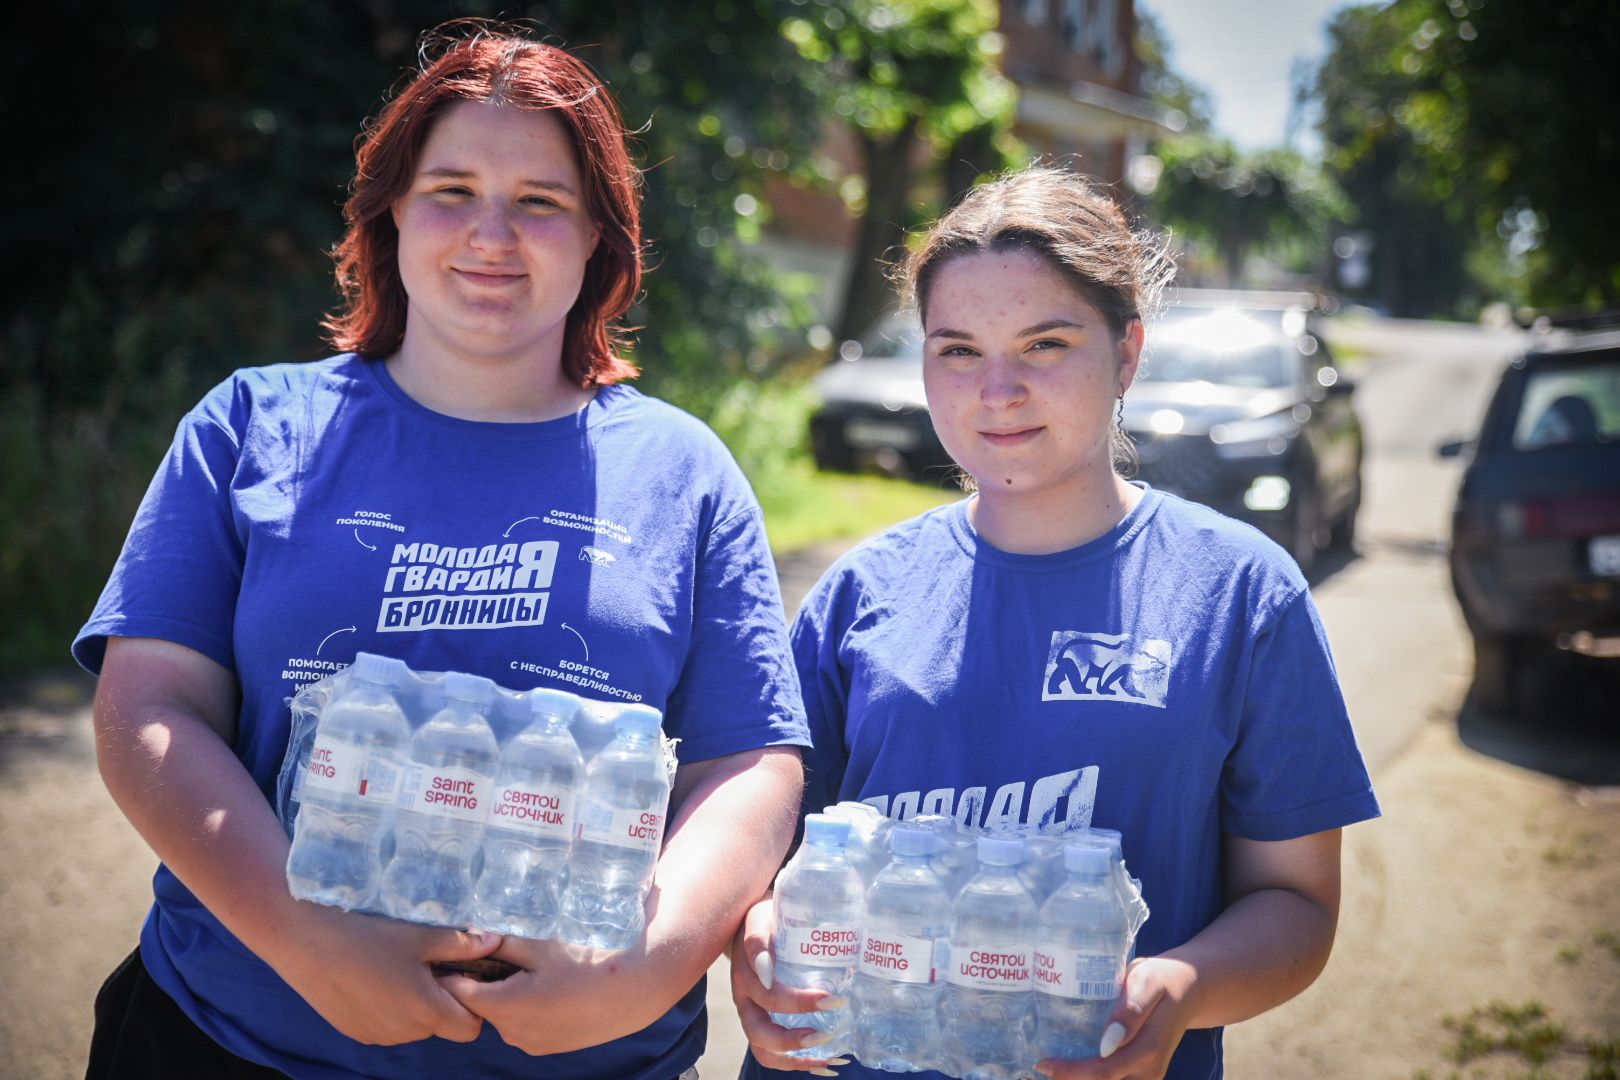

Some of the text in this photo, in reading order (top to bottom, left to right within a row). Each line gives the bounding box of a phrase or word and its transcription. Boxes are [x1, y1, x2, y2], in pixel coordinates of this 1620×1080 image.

[336, 518, 406, 533] ПОКОЛЕНИЯ
[354, 510, 392, 521] ГОЛОС
[550, 509, 628, 534] ОРГАНИЗАЦИЯ
[542, 516, 632, 545] ВОЗМОЖНОСТЕЙ
[384, 598, 543, 628] БРОННИЦЫ
[281, 670, 332, 681] ВОПЛО
[558, 659, 610, 681] БОРЕТСЯ
[510, 661, 643, 702] С НЕСПРАВЕДЛИВОСТЬЮ
[424, 790, 478, 810] SPRING
[494, 802, 565, 825] ИСТОЧНИК
[800, 942, 861, 957] ИСТОЧНИ
[863, 950, 909, 971] SPRING
[960, 962, 1030, 981] ИСТОЧНИК
